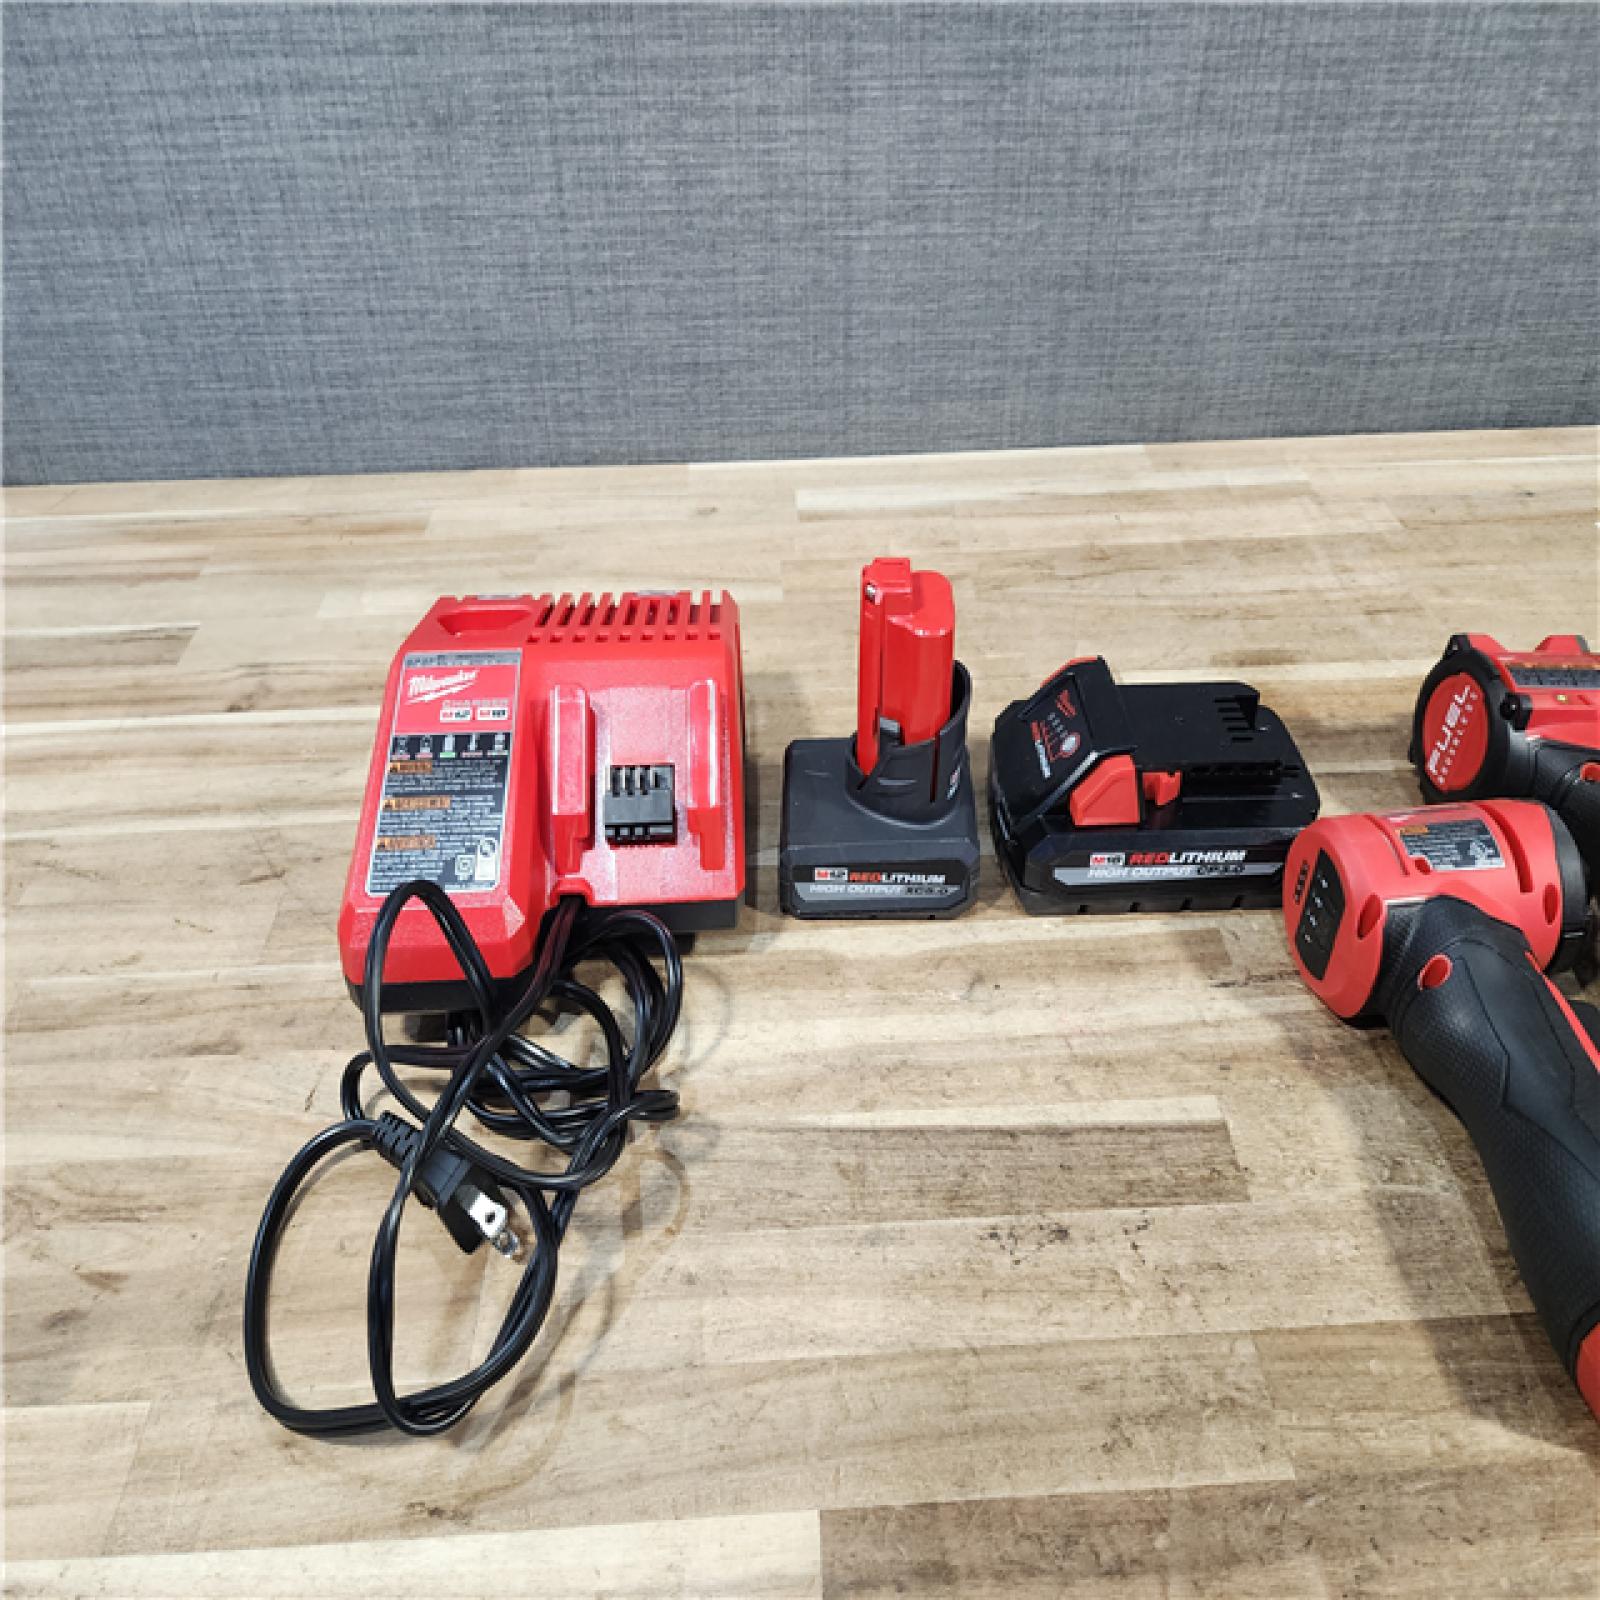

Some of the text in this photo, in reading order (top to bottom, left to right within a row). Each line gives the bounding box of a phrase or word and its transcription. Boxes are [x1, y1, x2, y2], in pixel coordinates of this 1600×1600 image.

[1129, 850, 1248, 866] REDLITHIUM
[849, 871, 946, 884] REDLITHIUM
[1088, 866, 1128, 879] HIGH
[1131, 865, 1194, 877] OUTPUT
[809, 884, 847, 894] HIGH
[848, 884, 900, 895] OUTPUT
